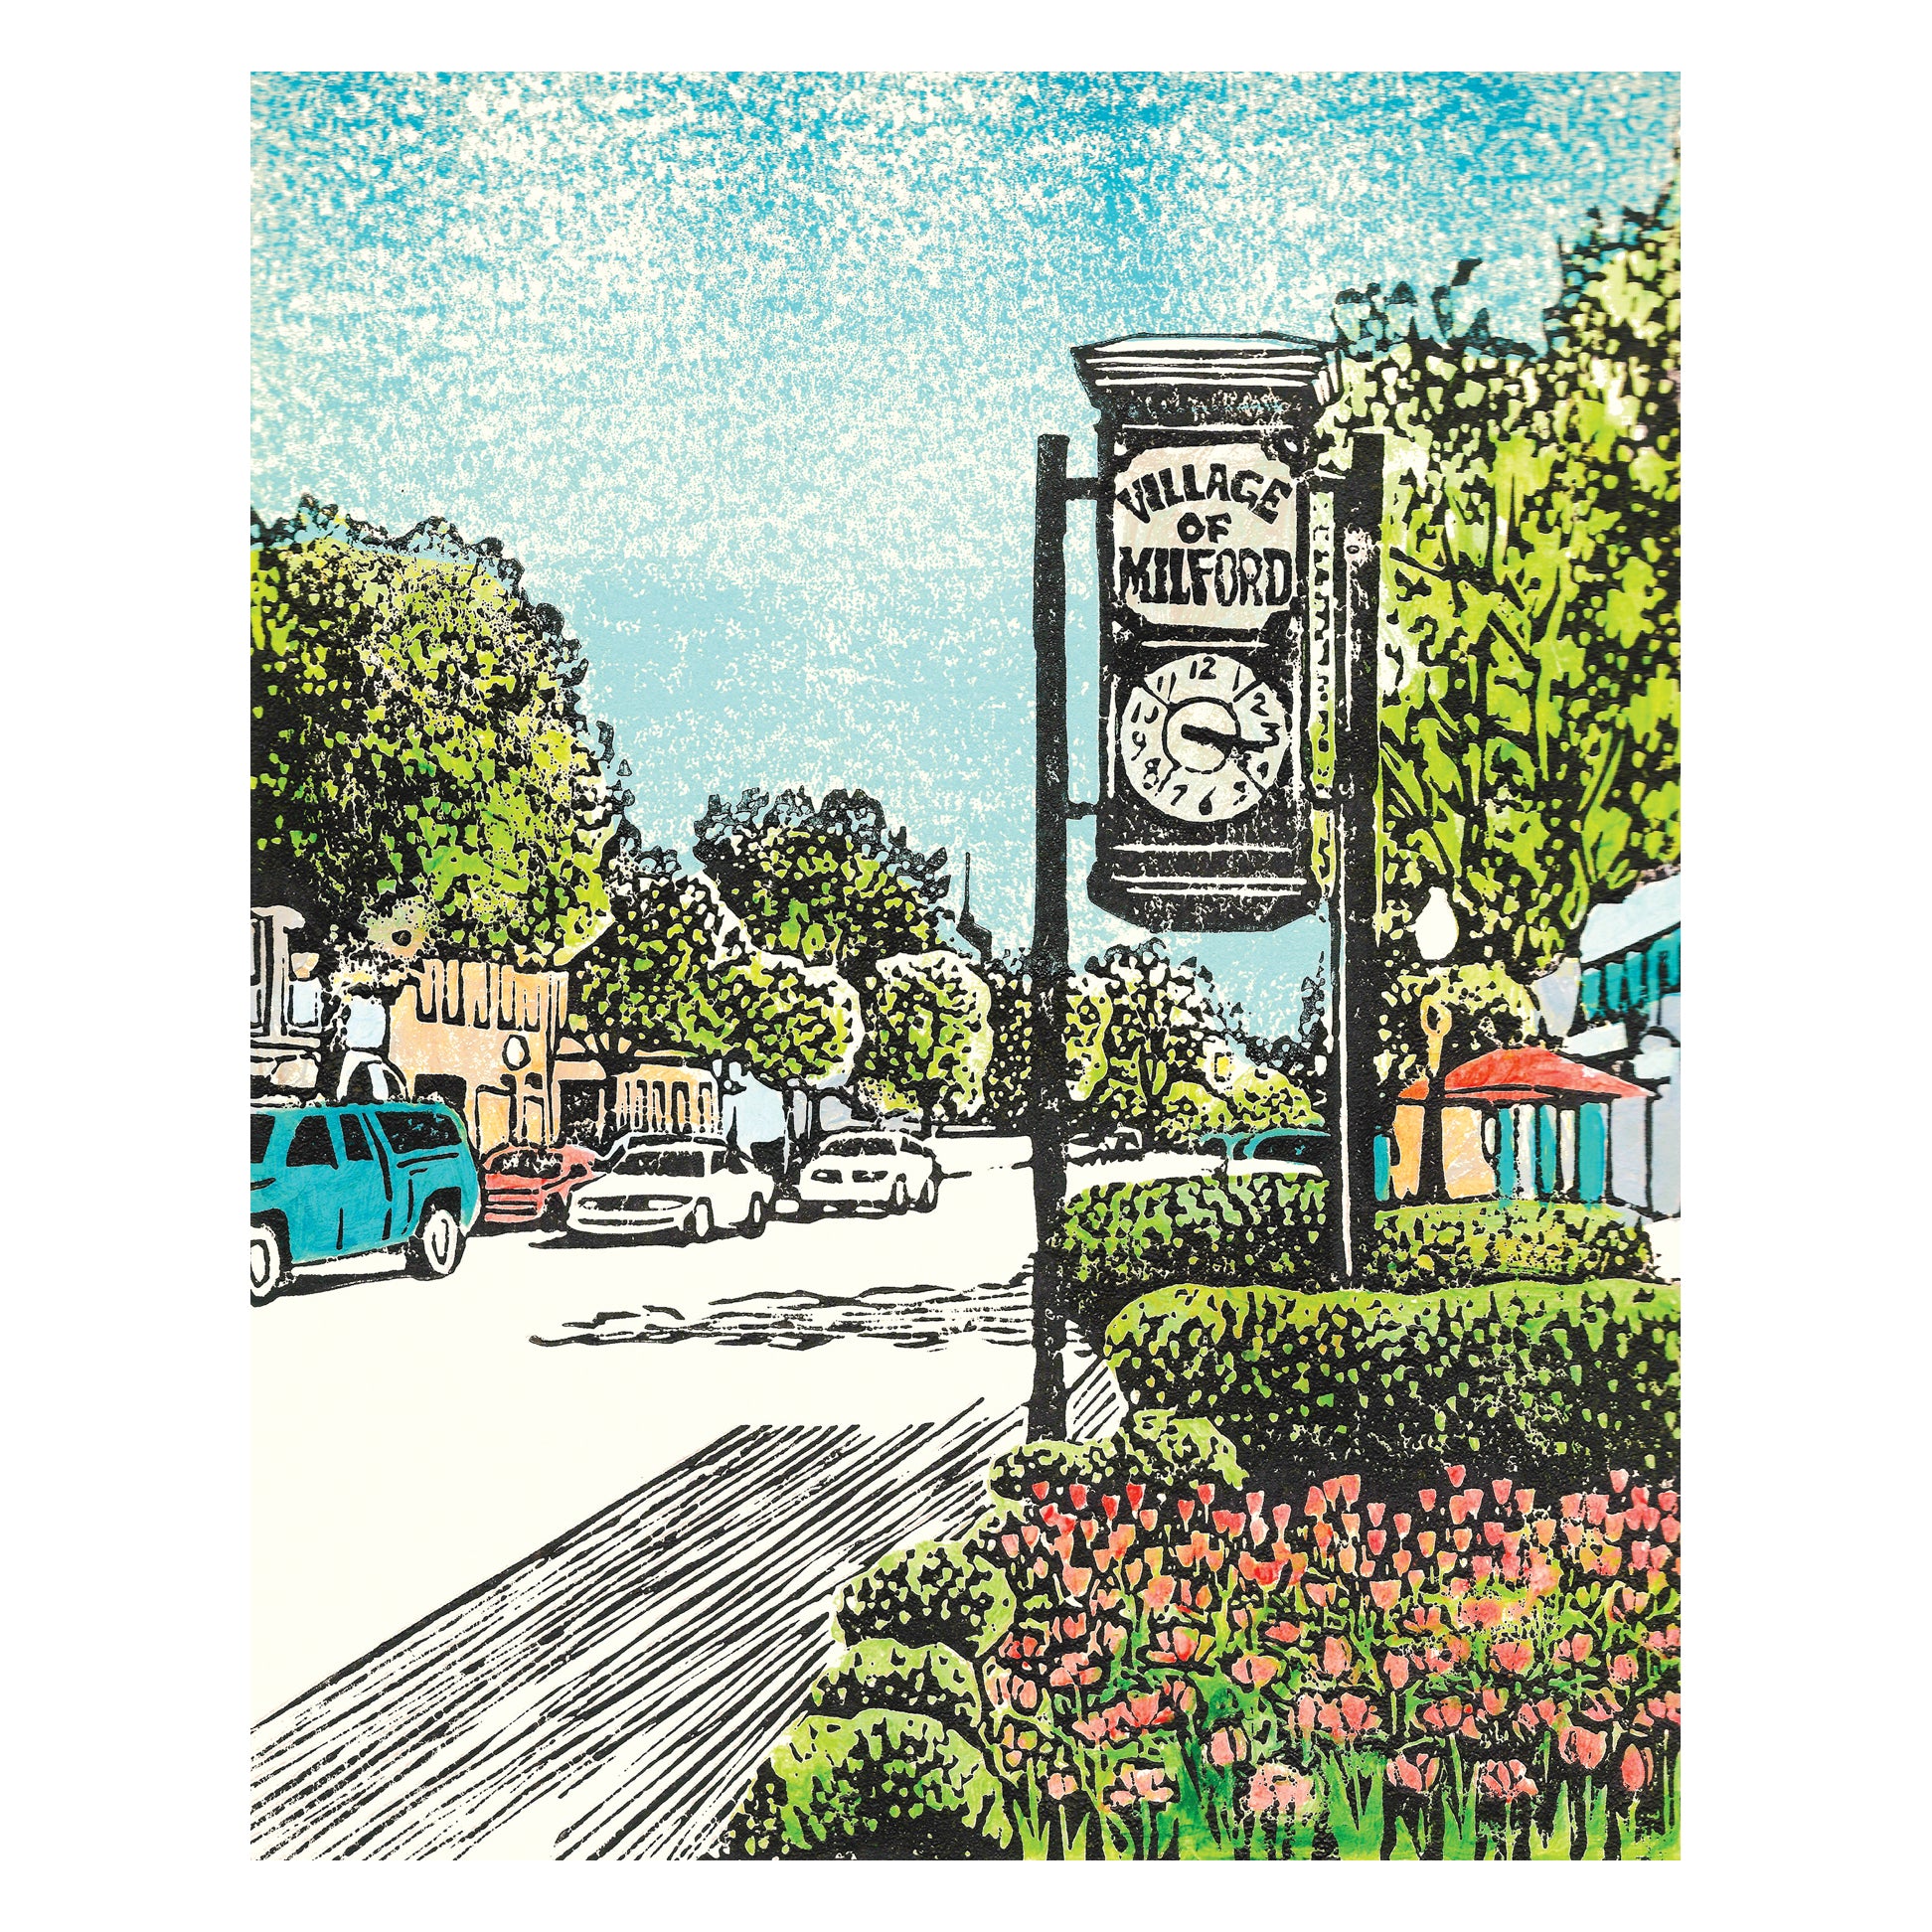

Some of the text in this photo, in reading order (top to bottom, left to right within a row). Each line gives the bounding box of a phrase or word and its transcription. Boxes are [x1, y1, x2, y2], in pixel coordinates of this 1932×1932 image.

[1117, 463, 1293, 524] VILLAGE
[1177, 512, 1232, 544] OF
[1119, 547, 1293, 606] MILFORD
[1189, 656, 1217, 680] 12
[1250, 693, 1269, 717] 2
[1131, 731, 1147, 761] 9
[1142, 758, 1161, 790] 8
[1171, 784, 1189, 806] 7
[1199, 786, 1216, 816] 6
